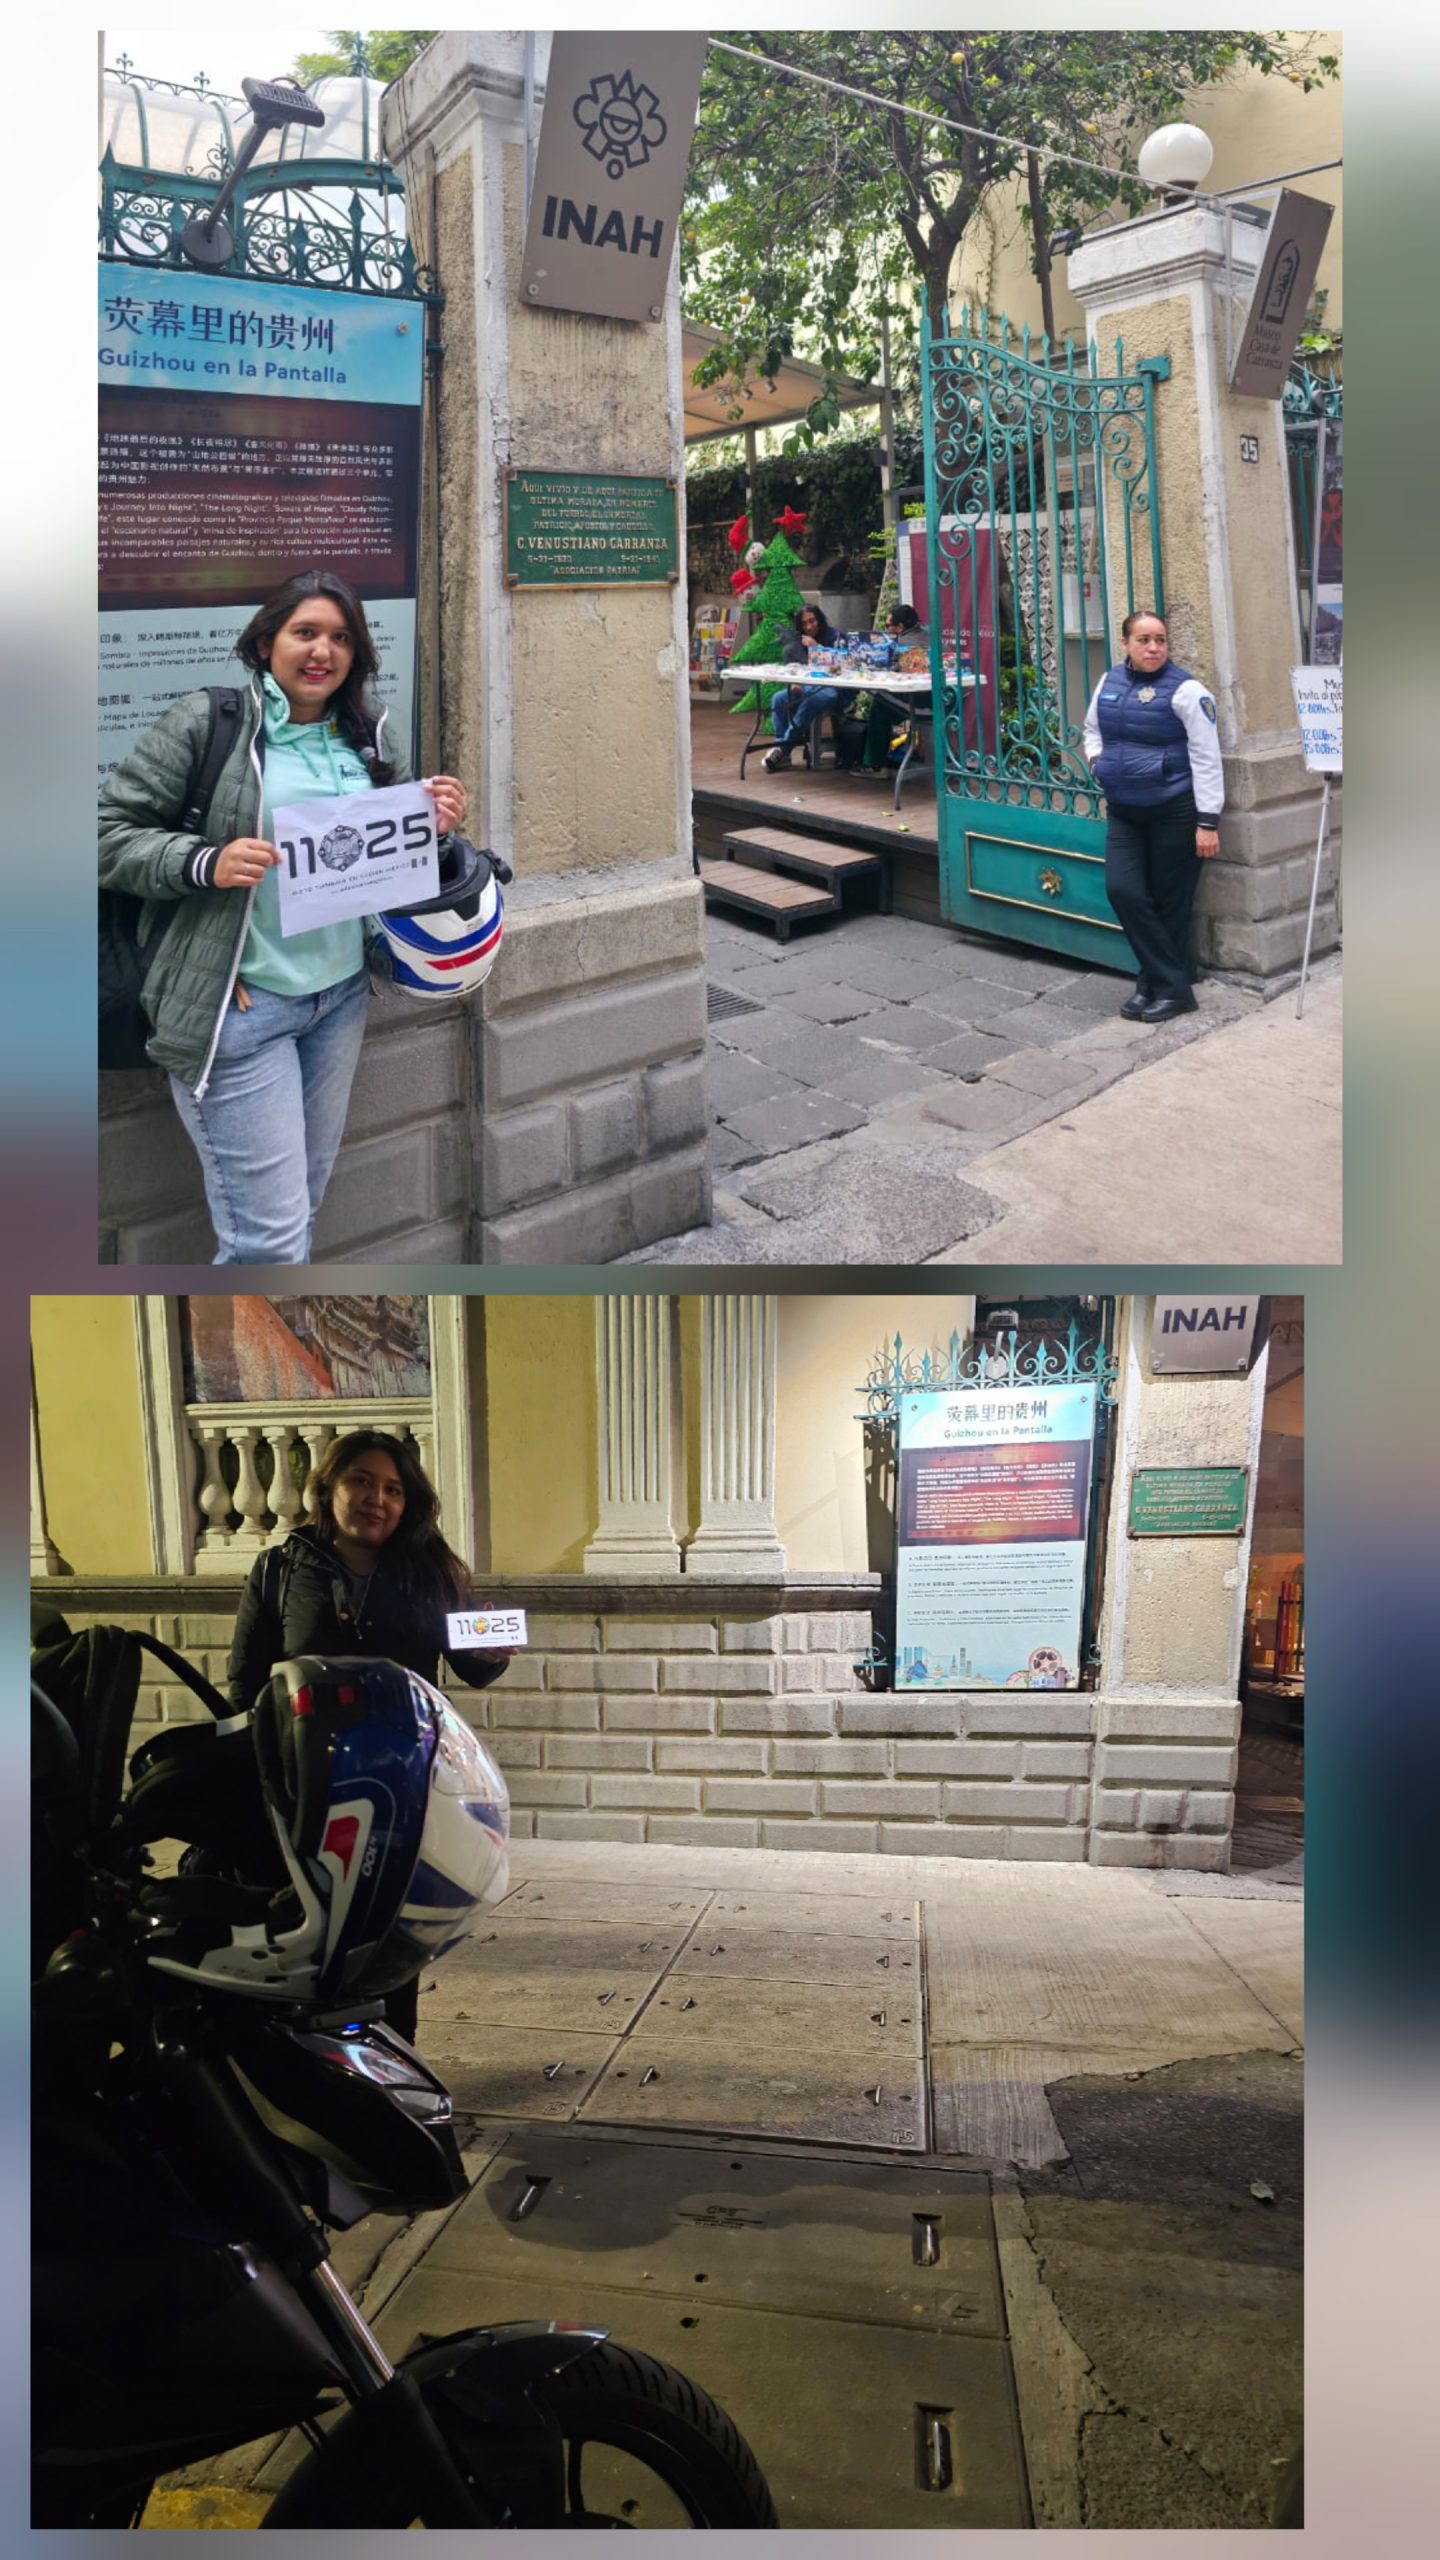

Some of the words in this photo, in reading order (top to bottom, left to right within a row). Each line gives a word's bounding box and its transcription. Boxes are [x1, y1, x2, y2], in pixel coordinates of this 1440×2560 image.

[542, 195, 664, 258] INAH
[104, 296, 334, 354] 荧幕里的贵州
[98, 347, 196, 373] Guizhou
[204, 360, 230, 375] en
[239, 359, 257, 378] la
[265, 361, 347, 384] Pantalla
[1241, 437, 1259, 462] 35
[528, 536, 606, 550] VENUSTIANO
[609, 537, 668, 550] CARRANZA
[1161, 1305, 1248, 1334] INAH
[947, 1399, 1048, 1423] 荧幕里的贵州
[944, 1428, 983, 1440] Guizhou
[986, 1428, 999, 1437] en
